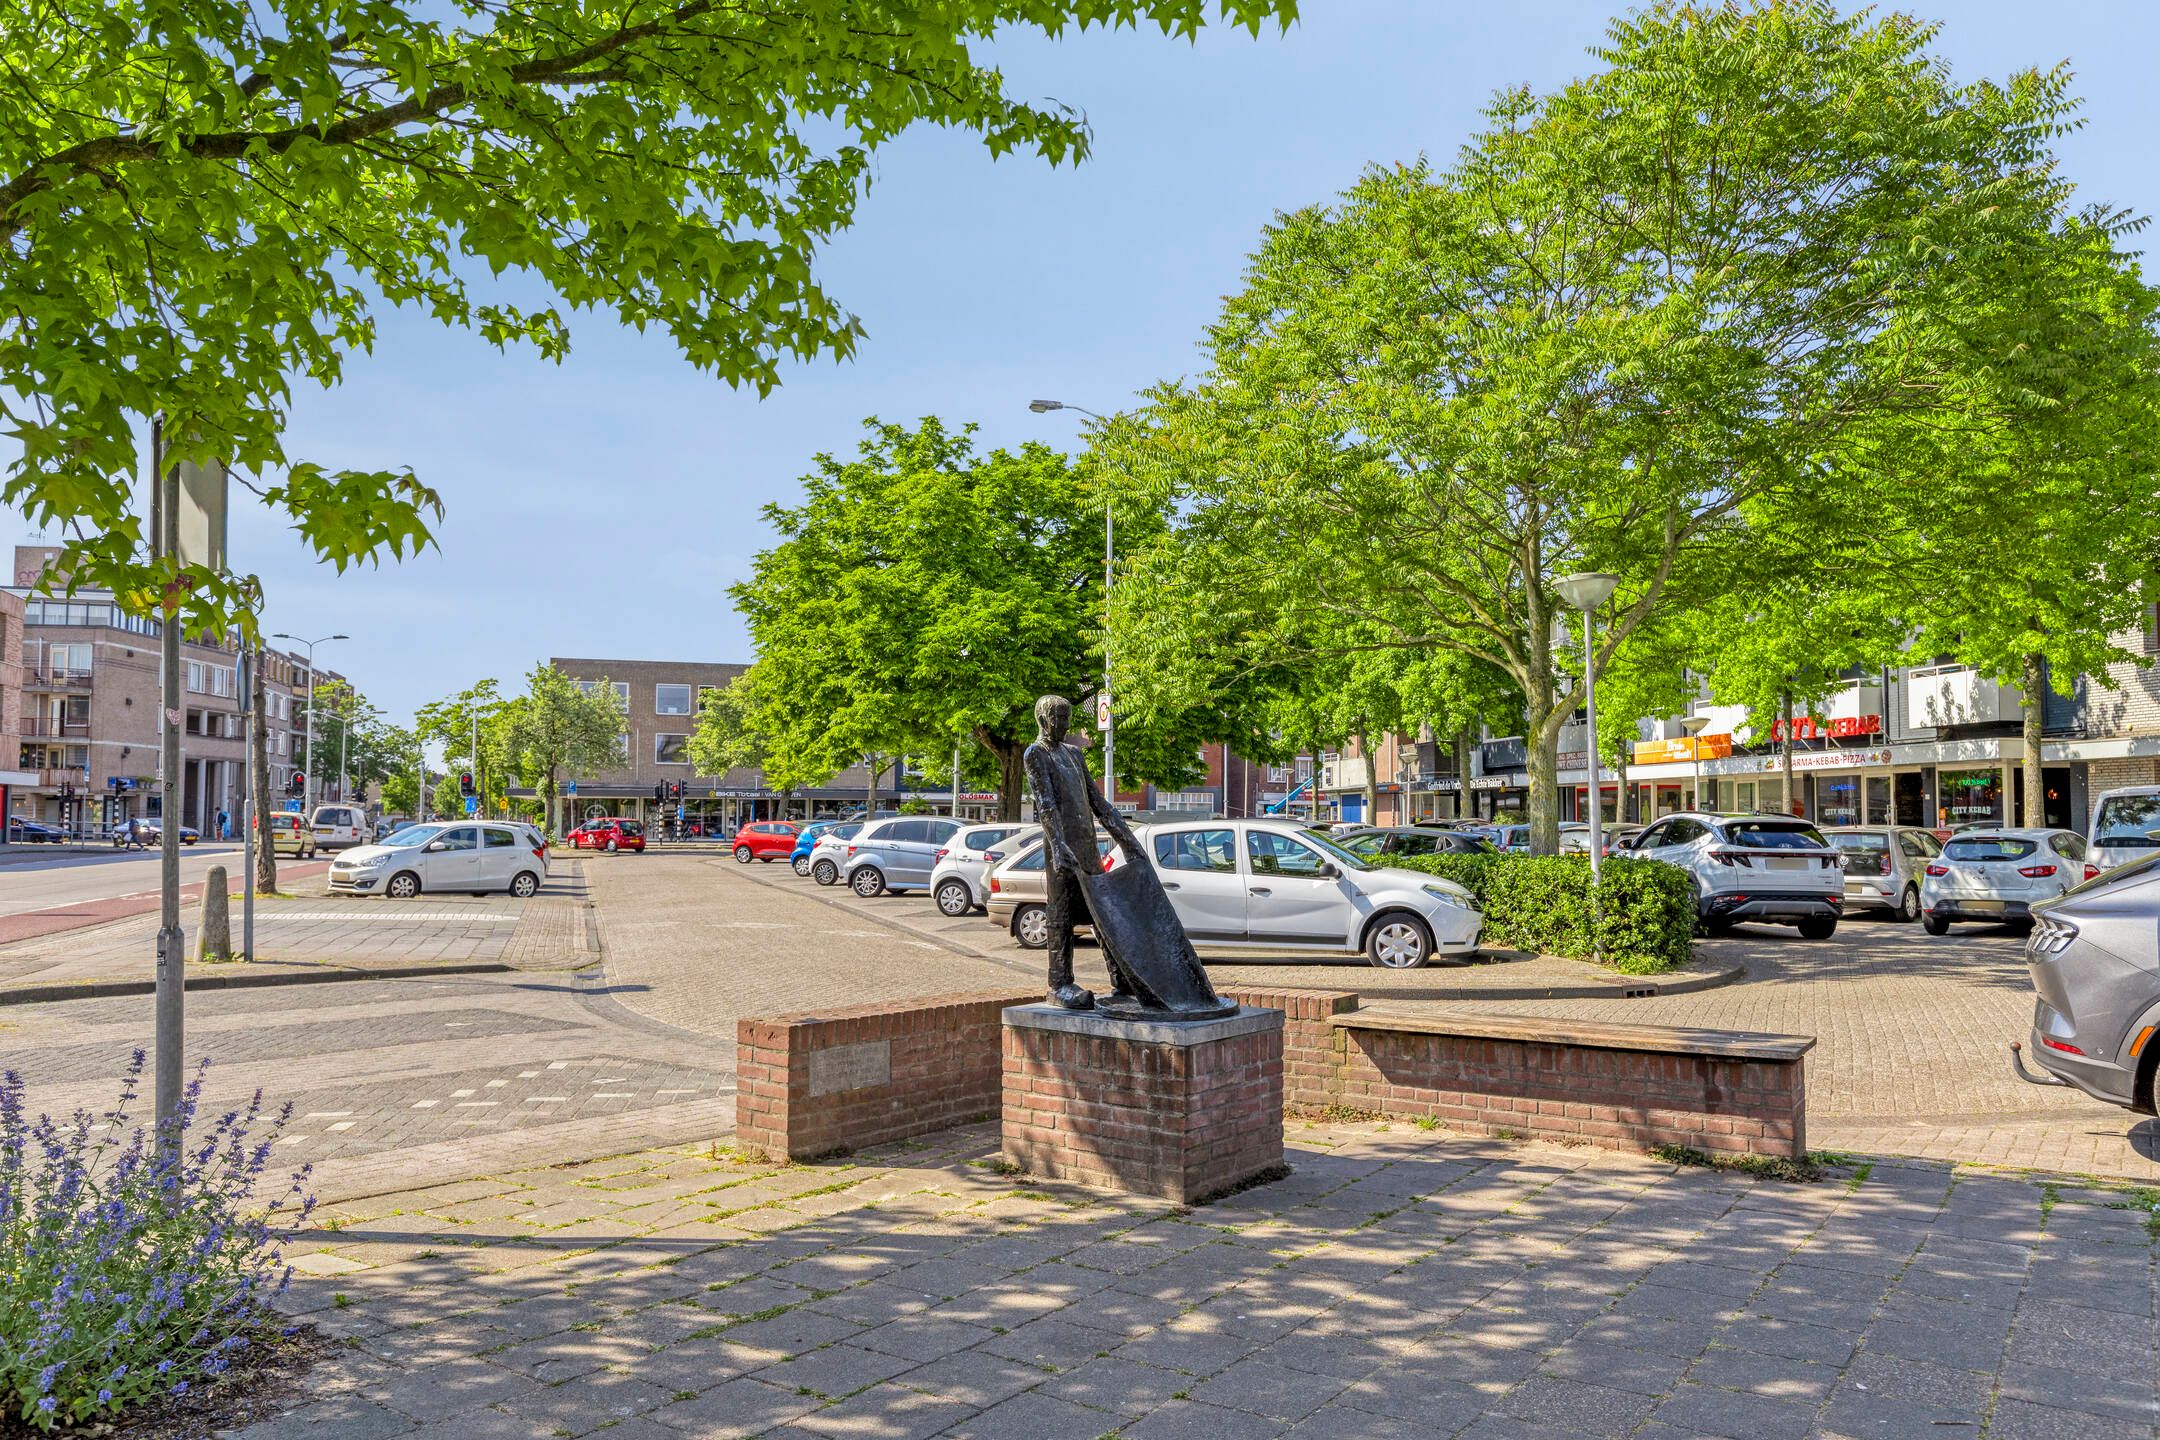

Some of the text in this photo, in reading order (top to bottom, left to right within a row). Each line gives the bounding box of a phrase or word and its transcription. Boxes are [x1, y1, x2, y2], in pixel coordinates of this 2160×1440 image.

[1771, 714, 1880, 742] CTY KEBAB
[1778, 754, 1866, 768] SARMA-KEBAB-PIZZA
[1476, 779, 1487, 789] Echte
[1487, 778, 1503, 788] Bakker
[1952, 806, 1992, 815] CITY KEBAB
